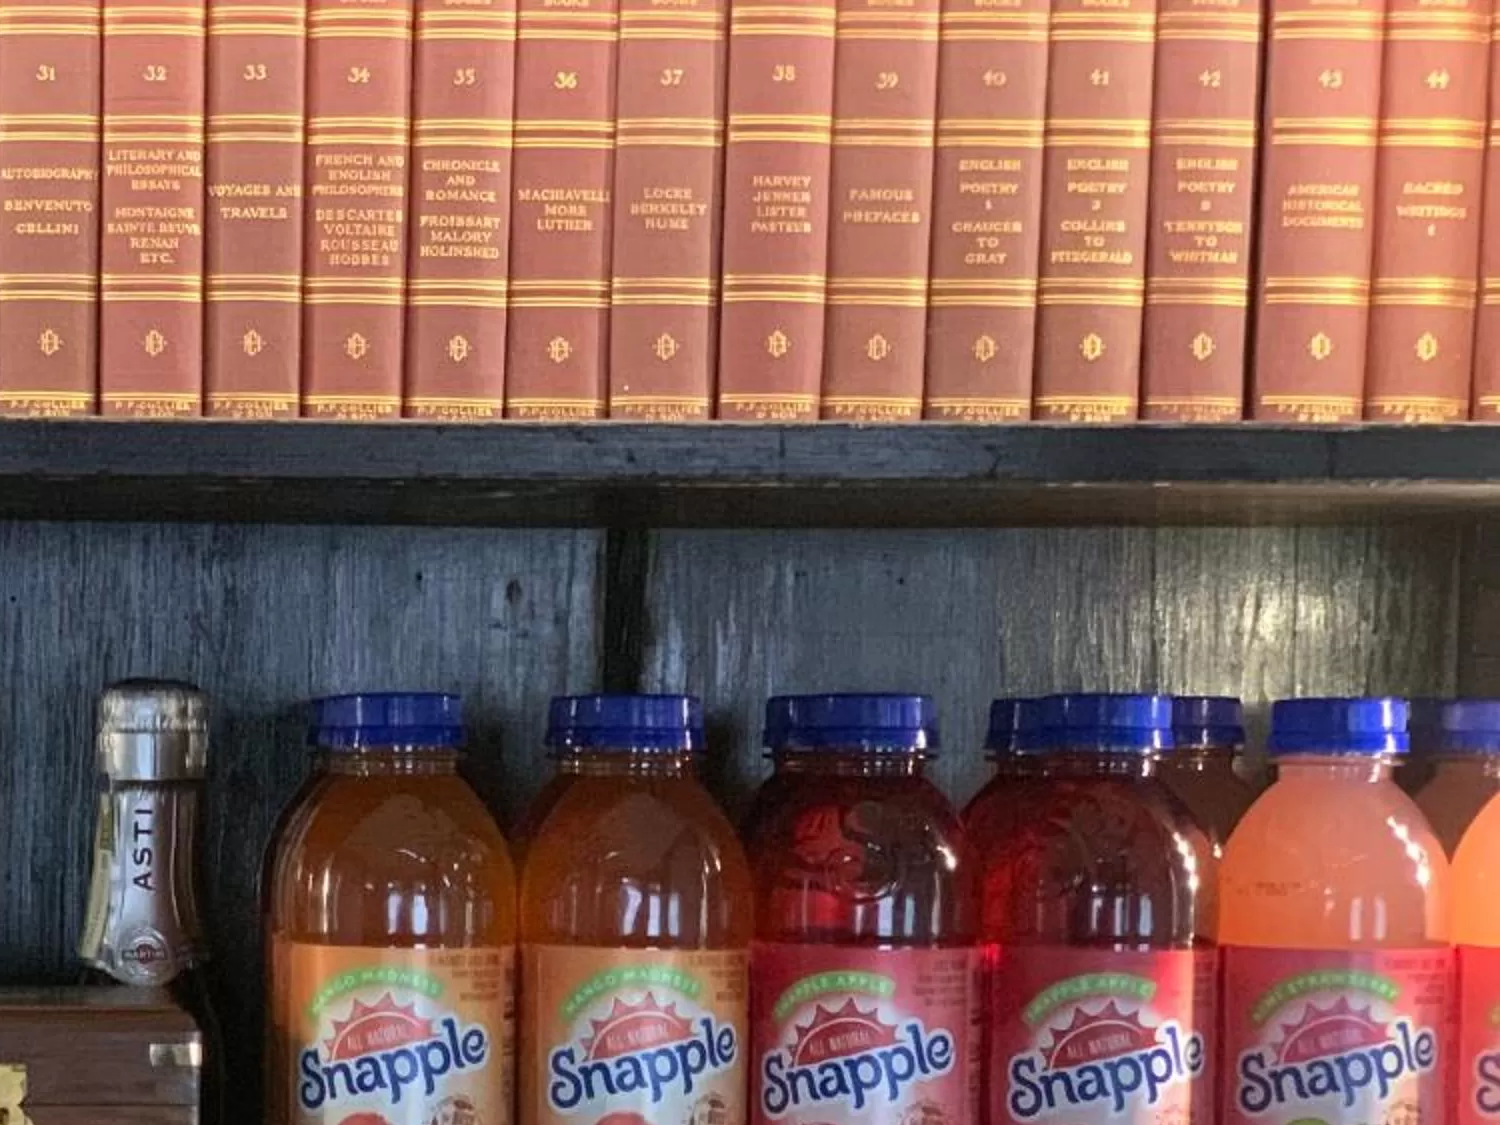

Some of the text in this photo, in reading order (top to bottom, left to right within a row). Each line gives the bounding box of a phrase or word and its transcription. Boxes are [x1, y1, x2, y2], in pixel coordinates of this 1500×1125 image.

[35, 65, 56, 81] 31
[143, 65, 167, 81] 32
[243, 64, 267, 80] 33
[347, 67, 370, 83] 34
[453, 69, 476, 85] 35
[660, 69, 684, 86] 37
[772, 65, 796, 82] 38
[982, 69, 1007, 87] 40
[1090, 68, 1109, 86] 41
[1199, 69, 1221, 87] 42
[554, 72, 578, 89] 36
[875, 72, 899, 89] 39
[109, 150, 201, 162] LITERARY AND
[315, 155, 405, 168] FRENCH AND
[106, 164, 203, 177] PHILOSOPHICAL
[423, 160, 500, 173] CHRONICLE
[958, 159, 1021, 171] ENGLISH
[1067, 159, 1129, 171] ENGLISH
[1176, 159, 1238, 171] ENGLISH
[327, 170, 392, 181] ENGLISH
[447, 176, 476, 187] AND
[131, 180, 181, 191] ESSAYS
[753, 176, 812, 188] HARVEY
[1067, 182, 1128, 193] POETRY
[1177, 181, 1236, 193] POETRY
[208, 185, 270, 197] VOYAGES
[312, 185, 404, 197] PHILOSOPHERS
[643, 188, 693, 199] LOCKE
[849, 189, 914, 201] FAMOUS
[959, 183, 1019, 195] POETRY
[425, 190, 496, 202] ROMANCE
[517, 189, 610, 202] MACHIAVELLI
[752, 191, 812, 203] JENNER
[3, 200, 93, 212] BENVENUTO
[544, 205, 588, 217] MORE
[630, 204, 708, 216] BERKELEY
[757, 206, 808, 217] LISTER
[115, 207, 195, 219] MONTAIGNE
[220, 207, 288, 219] TRAVELS
[315, 209, 403, 223] DESCARTES
[843, 211, 920, 224] PREFACES
[419, 215, 501, 229] FROISSART
[536, 219, 594, 231] LUTHER
[644, 219, 689, 230] HUME
[750, 222, 812, 233] PASTEUR
[952, 221, 1023, 233] CHAUCER
[1060, 220, 1126, 232] COLLINS
[15, 223, 80, 236] CELLINI
[323, 225, 396, 237] VOLTAIRE
[431, 231, 493, 243] MALORY
[976, 237, 1000, 248] TO
[1084, 235, 1105, 246] TO
[1194, 235, 1218, 247] TO
[129, 238, 179, 249] RENAN
[319, 240, 399, 252] ROUSSEAU
[419, 245, 500, 259] HOLINSHED
[1051, 251, 1133, 264] FITZGERALD
[1169, 251, 1238, 264] WHITMAN
[139, 253, 175, 264] ETC.
[329, 254, 390, 266] HOBBES
[965, 253, 1007, 264] GRAY
[132, 808, 155, 891] ASTI
[300, 1018, 486, 1110] Snapple
[550, 1016, 738, 1109] Snapple
[1241, 1021, 1435, 1113] Snapple
[764, 1024, 953, 1114] Snapple
[1010, 1024, 1203, 1118] Snapple
